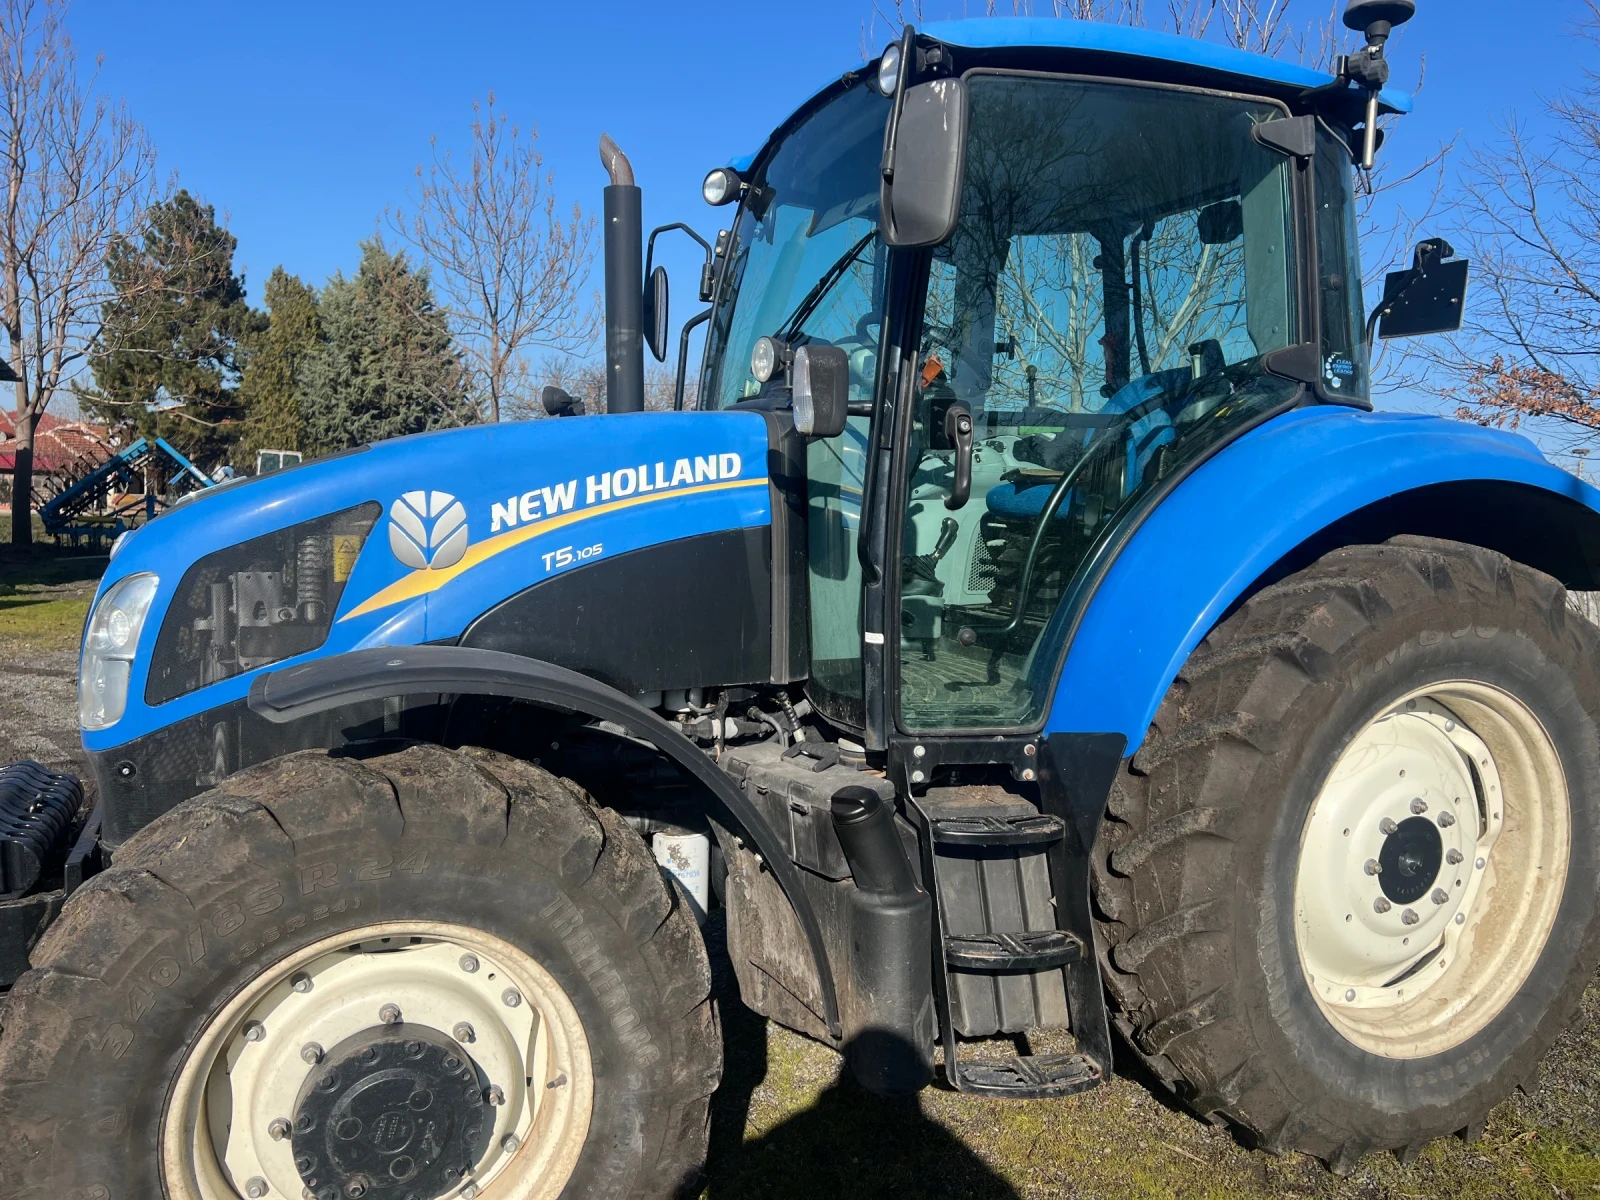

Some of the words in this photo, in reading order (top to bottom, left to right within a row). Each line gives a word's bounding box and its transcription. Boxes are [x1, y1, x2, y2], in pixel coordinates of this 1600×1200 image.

[490, 478, 578, 533] NEW
[586, 452, 742, 505] HOLLAND
[541, 542, 603, 573] T5.105
[100, 880, 286, 1061] 340/85
[301, 860, 340, 896] R
[357, 849, 431, 882] 24
[539, 889, 662, 1071] TRELLEBORG
